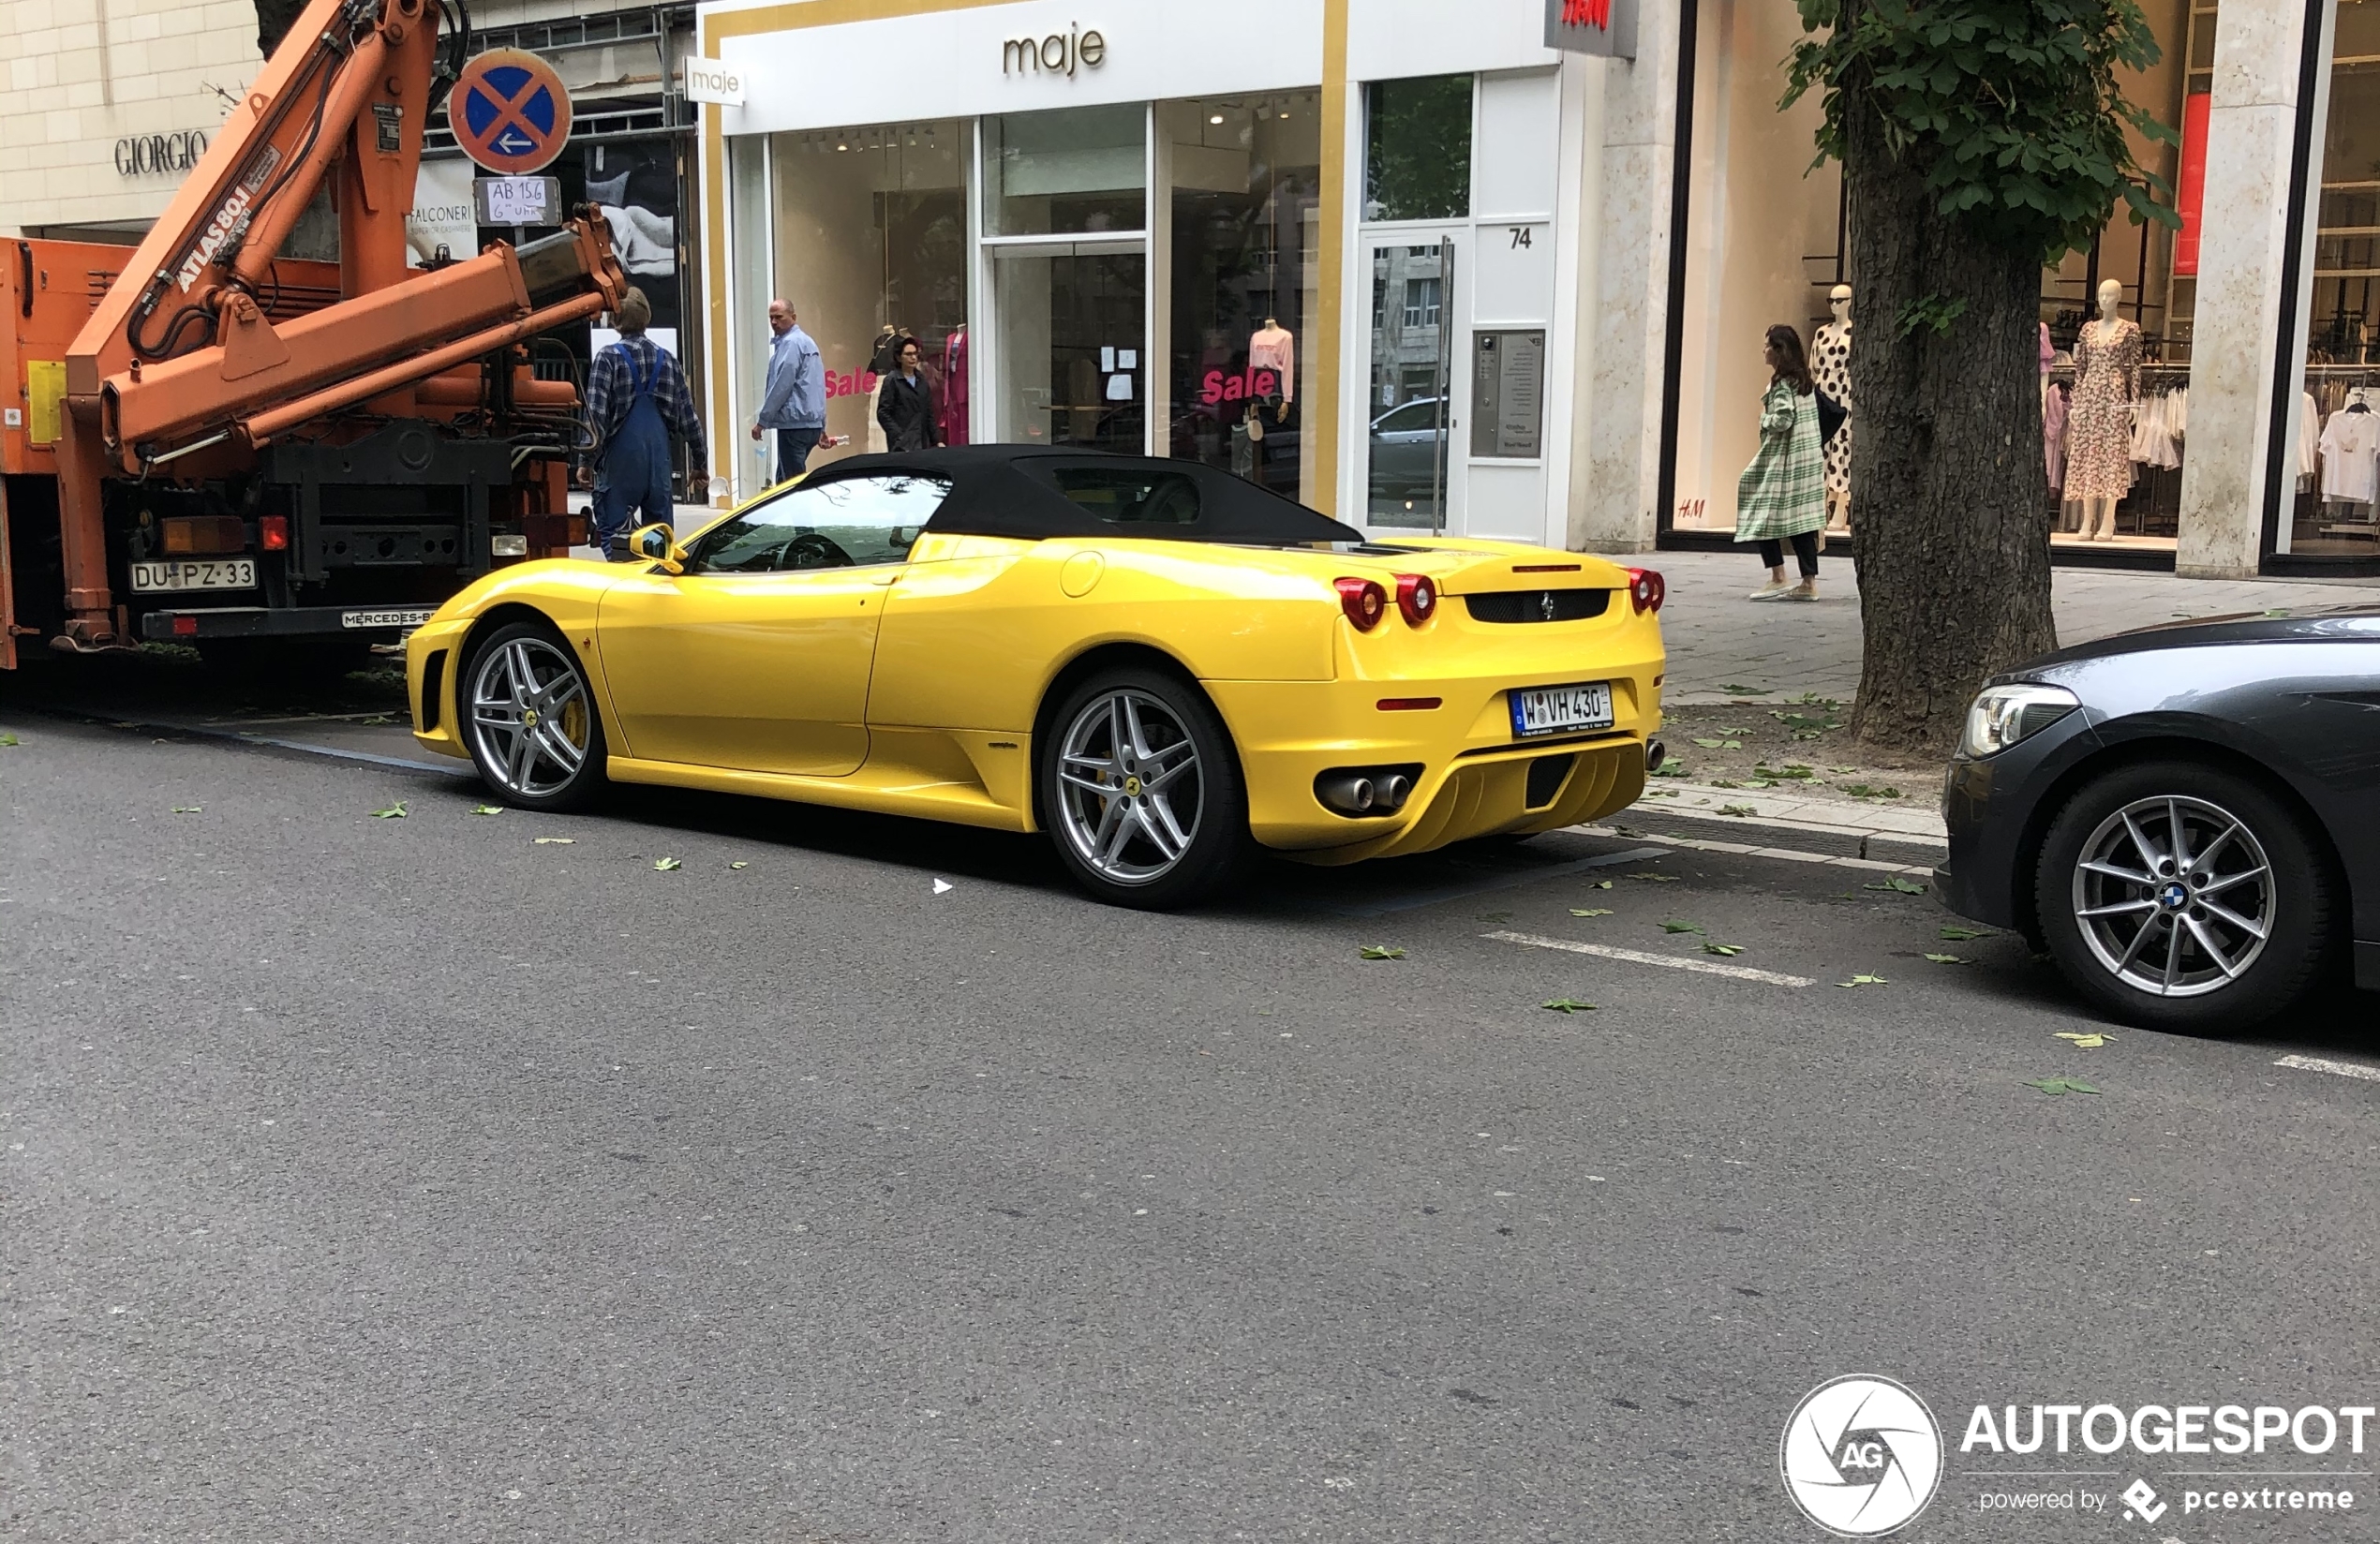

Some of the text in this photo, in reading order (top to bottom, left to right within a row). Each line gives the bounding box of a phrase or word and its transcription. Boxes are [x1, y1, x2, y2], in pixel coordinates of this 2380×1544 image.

[1003, 21, 1104, 77] maje
[692, 70, 738, 95] maje
[114, 130, 207, 176] GIORGIO
[492, 182, 514, 200] AB
[409, 206, 471, 223] FALCONERI
[1509, 227, 1532, 250] 74
[176, 223, 225, 294] ATLAS
[825, 365, 877, 399] Sale
[1202, 365, 1274, 405] Sale
[1677, 498, 1705, 519] H&M
[345, 612, 436, 625] MERCEDES-B
[1523, 694, 1536, 725] W
[1573, 689, 1600, 720] 430
